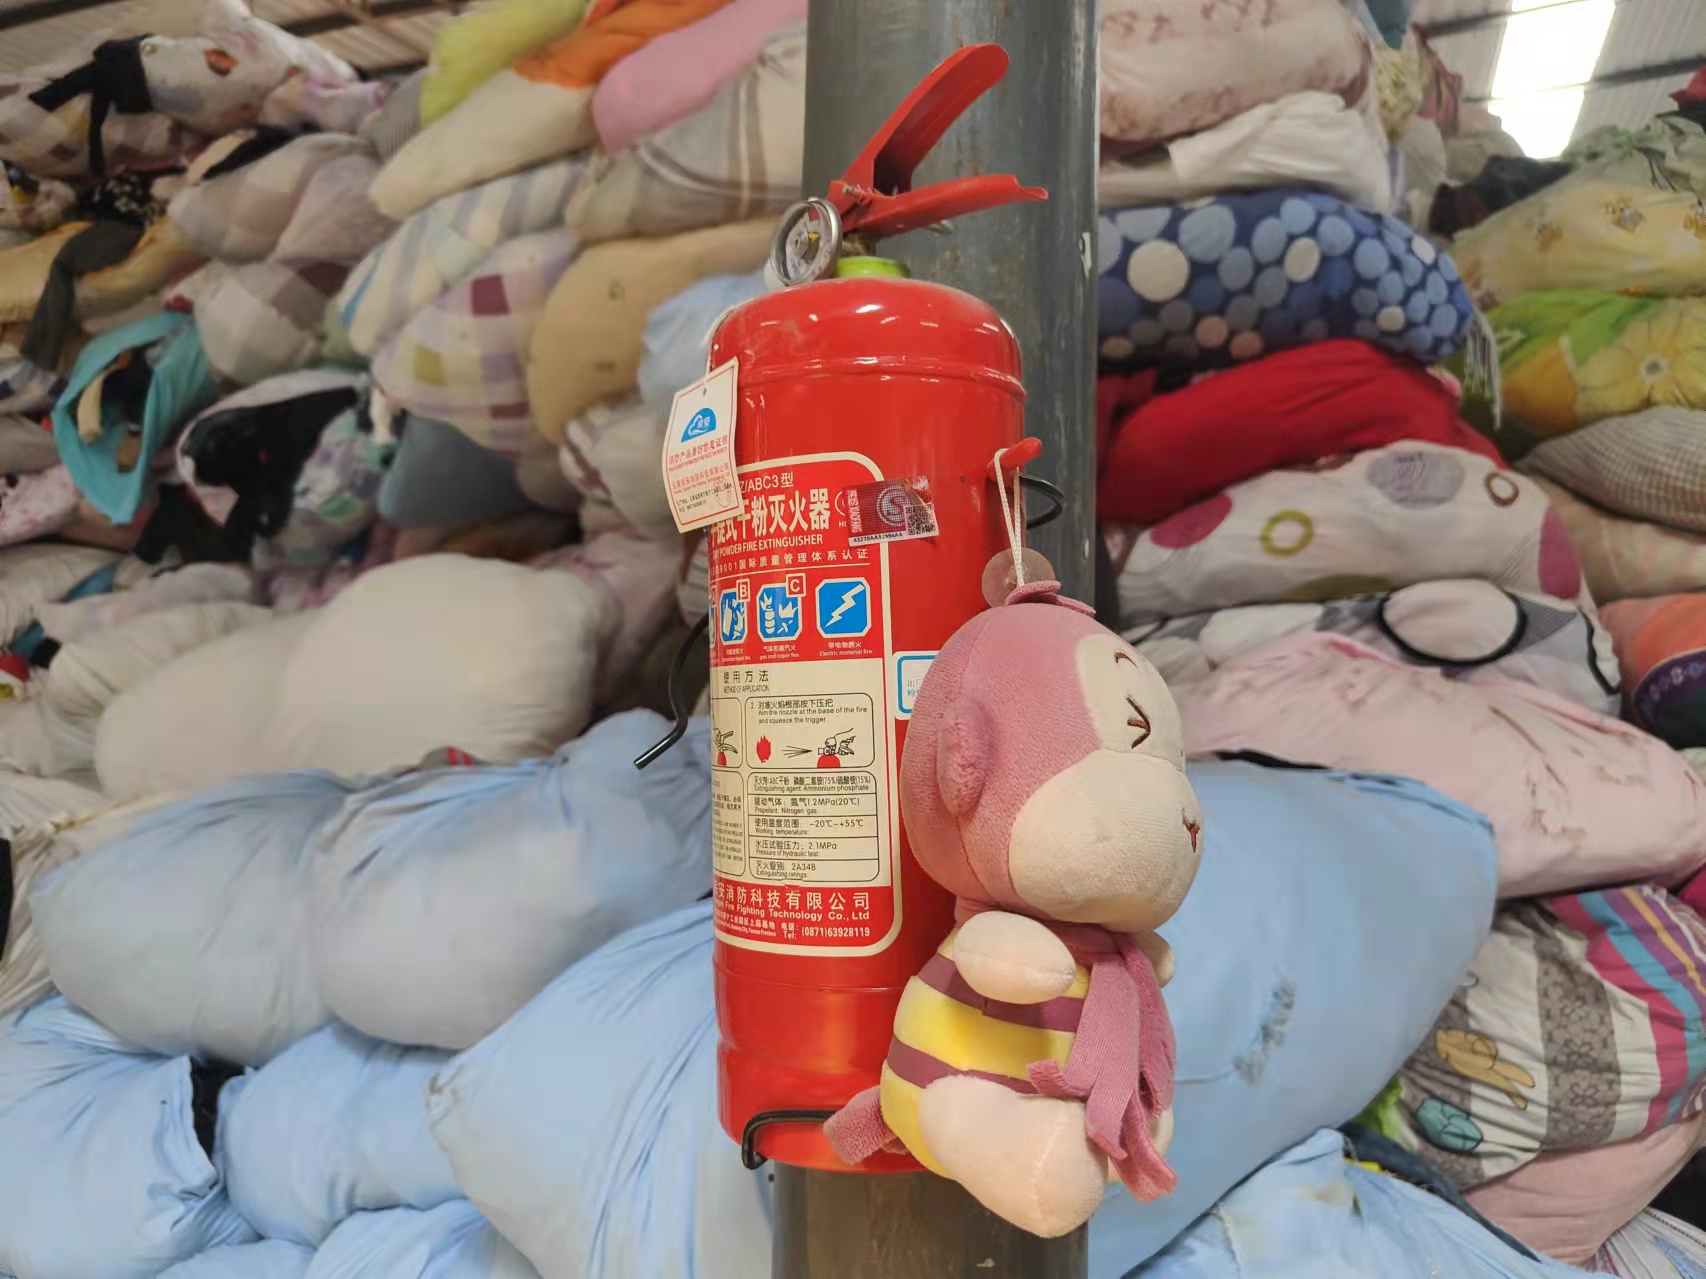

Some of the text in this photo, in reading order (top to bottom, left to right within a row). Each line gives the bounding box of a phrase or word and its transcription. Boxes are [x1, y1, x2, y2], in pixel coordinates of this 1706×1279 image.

[720, 542, 743, 558] POWDER
[742, 540, 758, 553] FIRE
[758, 533, 824, 550] EXTINGUISHER
[789, 579, 800, 593] C
[740, 584, 748, 598] B
[723, 669, 768, 684] 使用方法
[742, 684, 769, 693] APPLICATION
[856, 705, 868, 713] fire
[769, 717, 792, 725] squeeze
[805, 716, 826, 725] trigger
[837, 784, 870, 793] phosphate
[781, 807, 804, 815] Nitrogen
[755, 828, 774, 836] Working
[808, 841, 838, 850] 2.1MPa
[756, 849, 776, 857] Pressure
[782, 850, 807, 858] hydraulic
[756, 869, 788, 879] Extinguishing
[725, 901, 735, 911] Fire
[736, 904, 765, 918] Fighting
[768, 908, 823, 922] Technology
[828, 911, 850, 921] Co.,
[851, 911, 870, 920] Ltd
[801, 926, 871, 937] (0871)63928119
